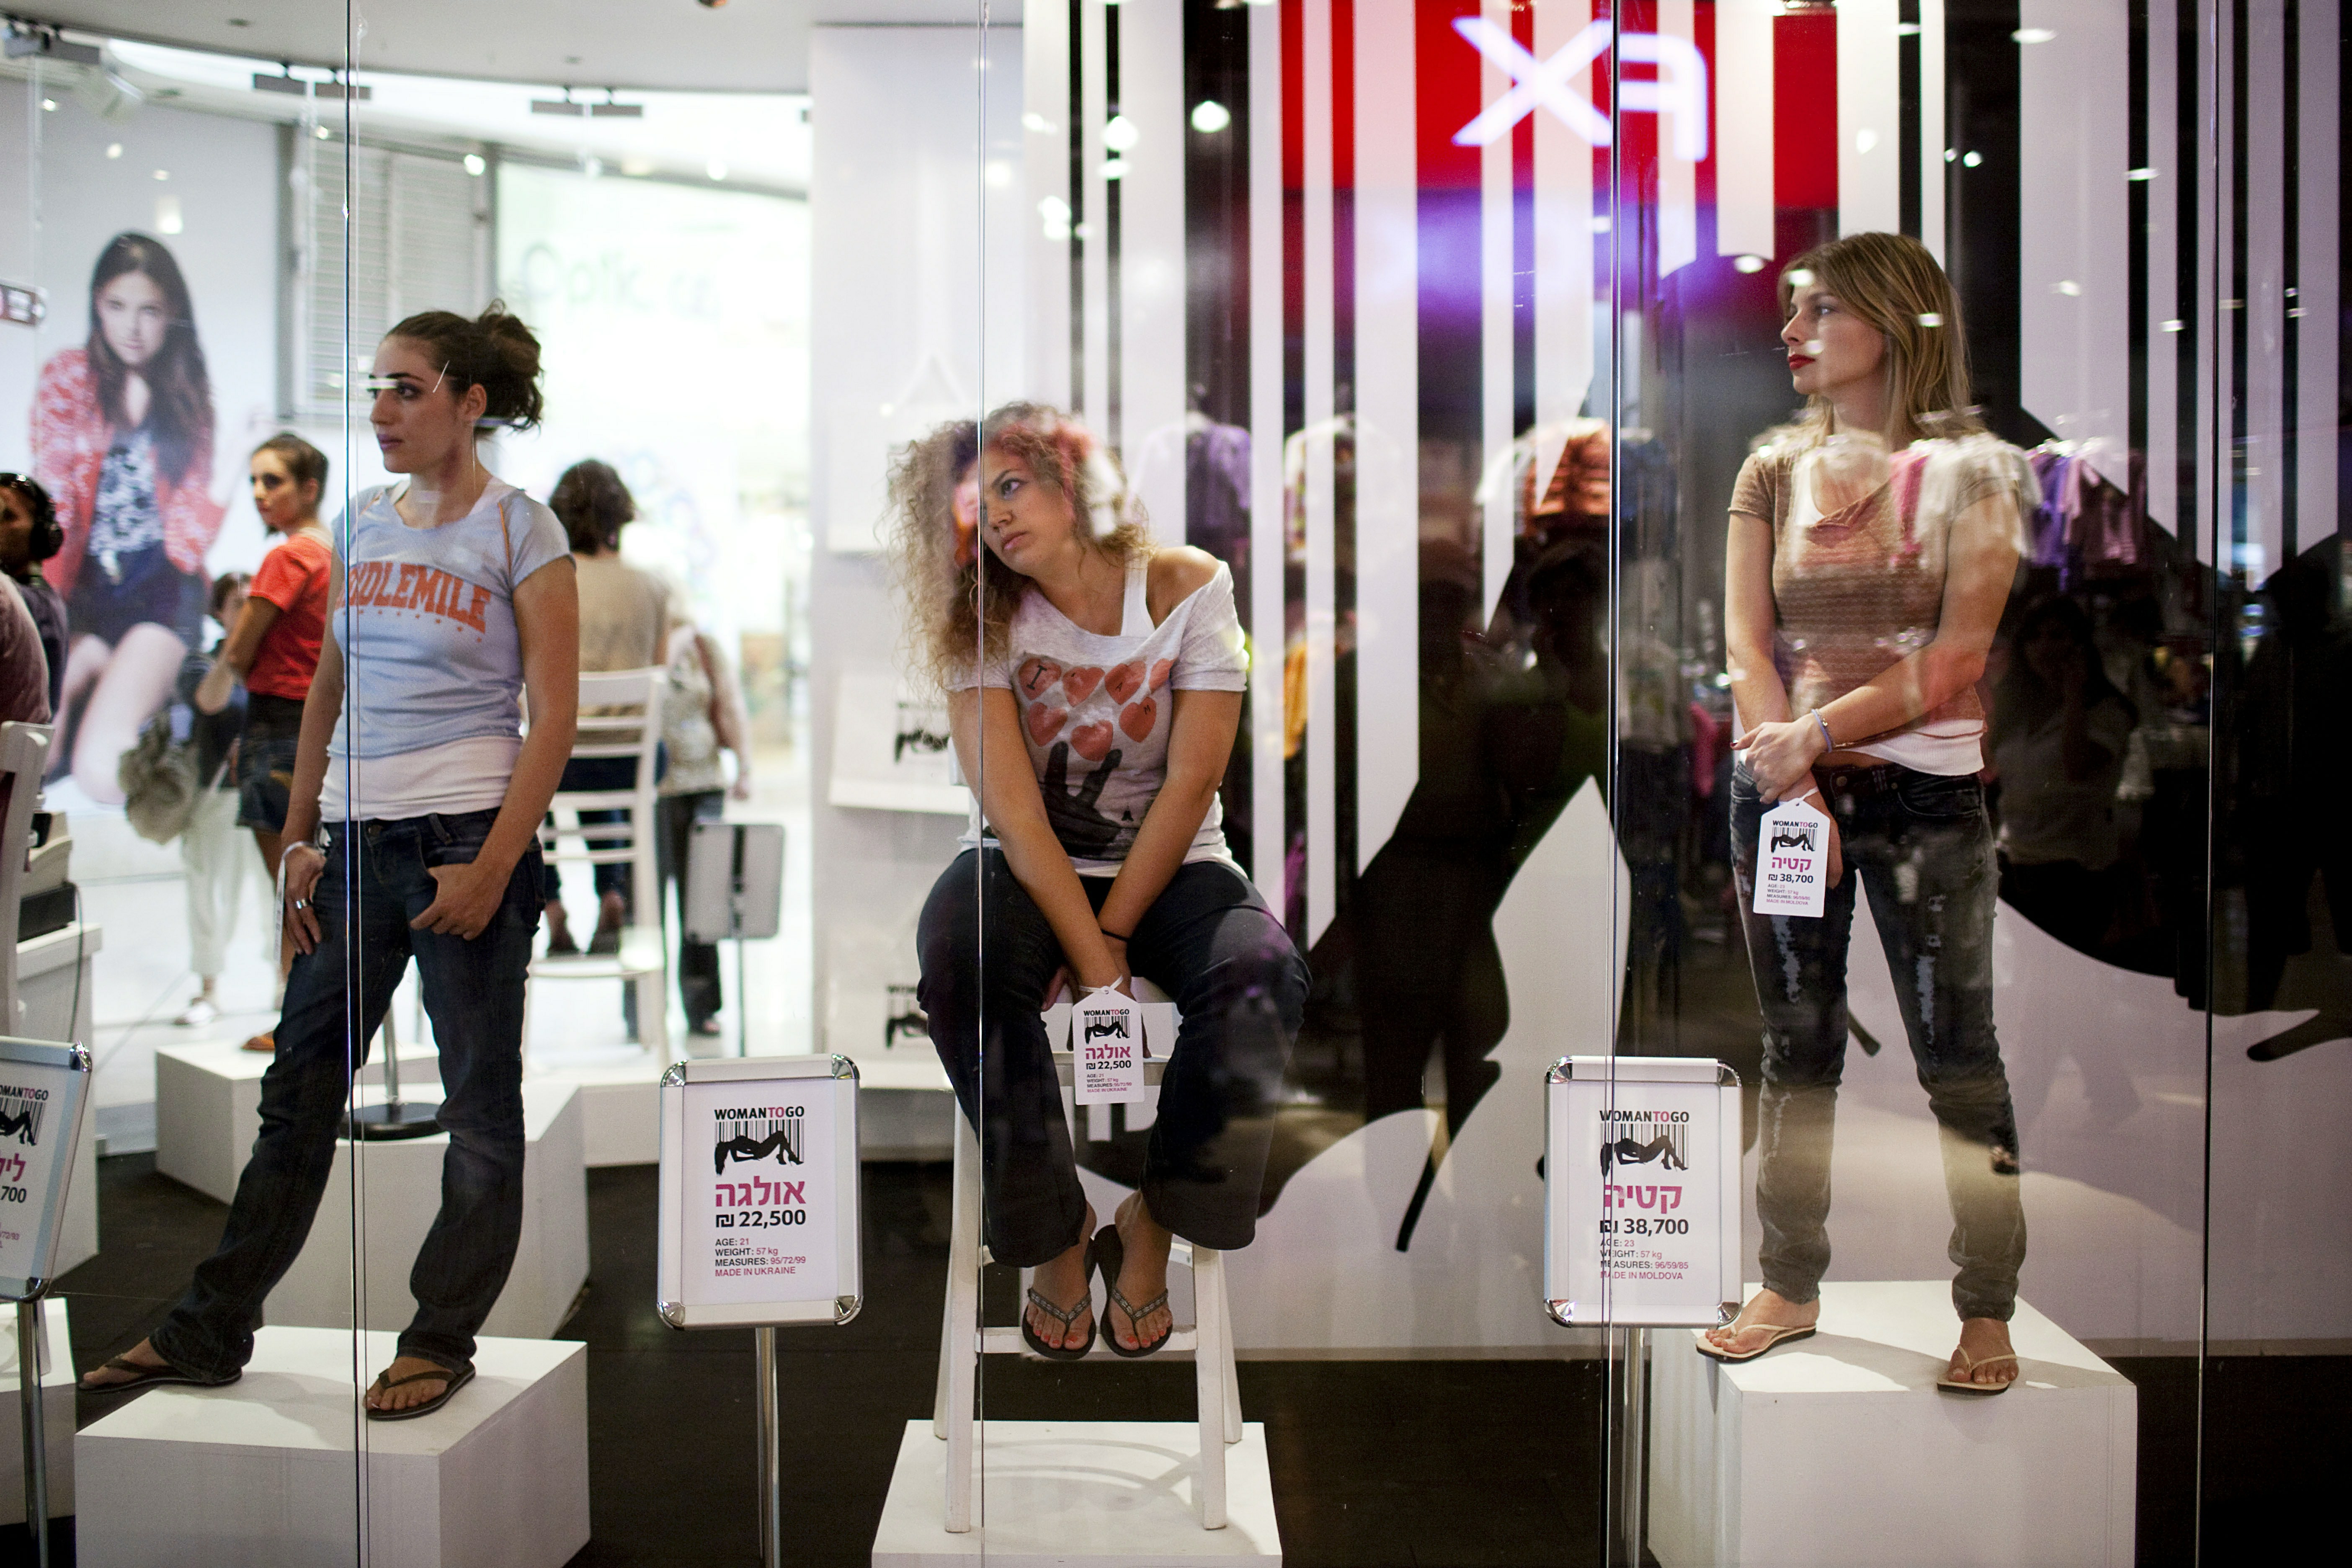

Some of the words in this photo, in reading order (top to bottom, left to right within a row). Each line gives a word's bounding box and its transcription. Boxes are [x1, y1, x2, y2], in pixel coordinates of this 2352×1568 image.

[1772, 857, 1812, 872] קטיה
[1779, 873, 1813, 884] 38,700
[1086, 1044, 1131, 1060] אולגה
[1098, 1060, 1132, 1070] 22,500
[714, 1106, 805, 1120] WOMANTOGO
[1599, 1110, 1689, 1122] WOMANTOGO
[715, 1176, 806, 1207] אולגה
[739, 1209, 806, 1229] 22,500
[1624, 1218, 1689, 1236] 38,700
[715, 1248, 754, 1256] WEIGHT:
[768, 1247, 779, 1256] kg
[1600, 1249, 1638, 1258] WEIGHT:
[1652, 1250, 1662, 1259] kg
[715, 1257, 769, 1266] MEASURES:
[1600, 1260, 1653, 1269] MEASURES:
[754, 1266, 796, 1275] UKRAINE
